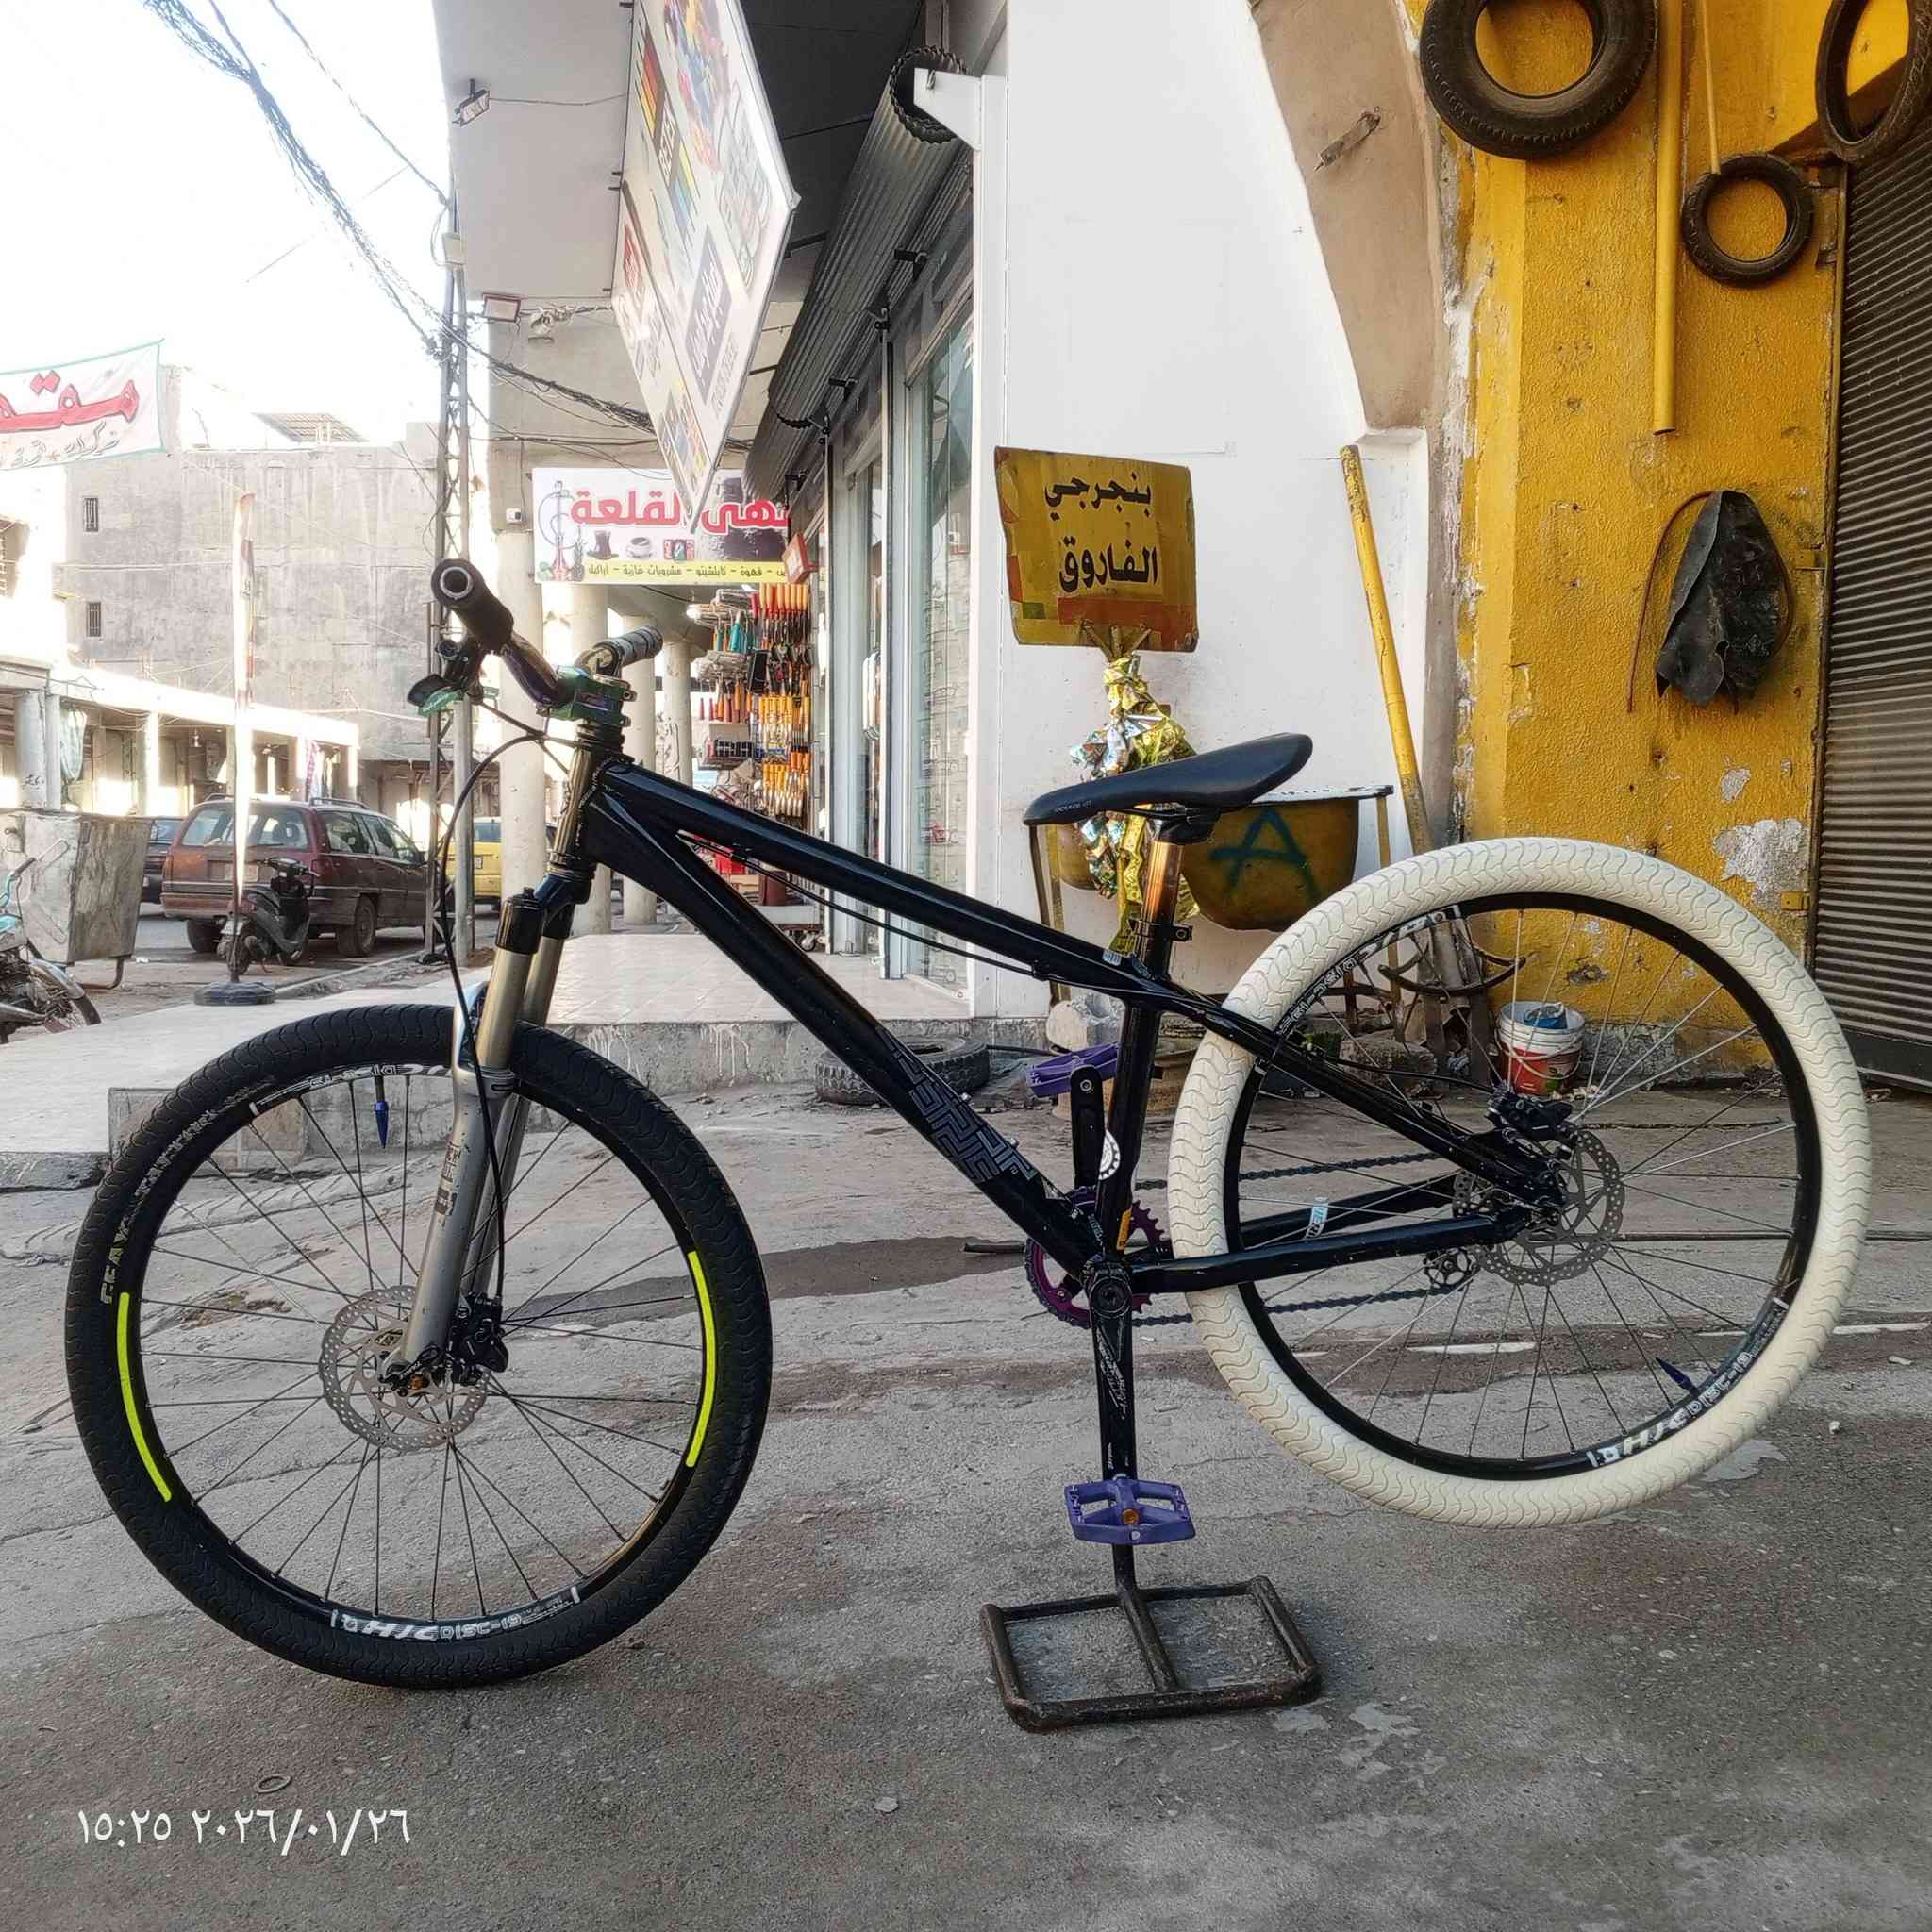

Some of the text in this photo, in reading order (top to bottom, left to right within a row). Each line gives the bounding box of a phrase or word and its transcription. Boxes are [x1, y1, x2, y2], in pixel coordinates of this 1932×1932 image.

[571, 490, 685, 526] لقلعة
[1044, 472, 1153, 521] بنجرجي
[647, 564, 682, 577] مشروبات
[741, 565, 763, 577] قهوة
[1058, 536, 1159, 592] الفاروق
[1208, 808, 1323, 901] A
[439, 1613, 522, 1641] DISC-19
